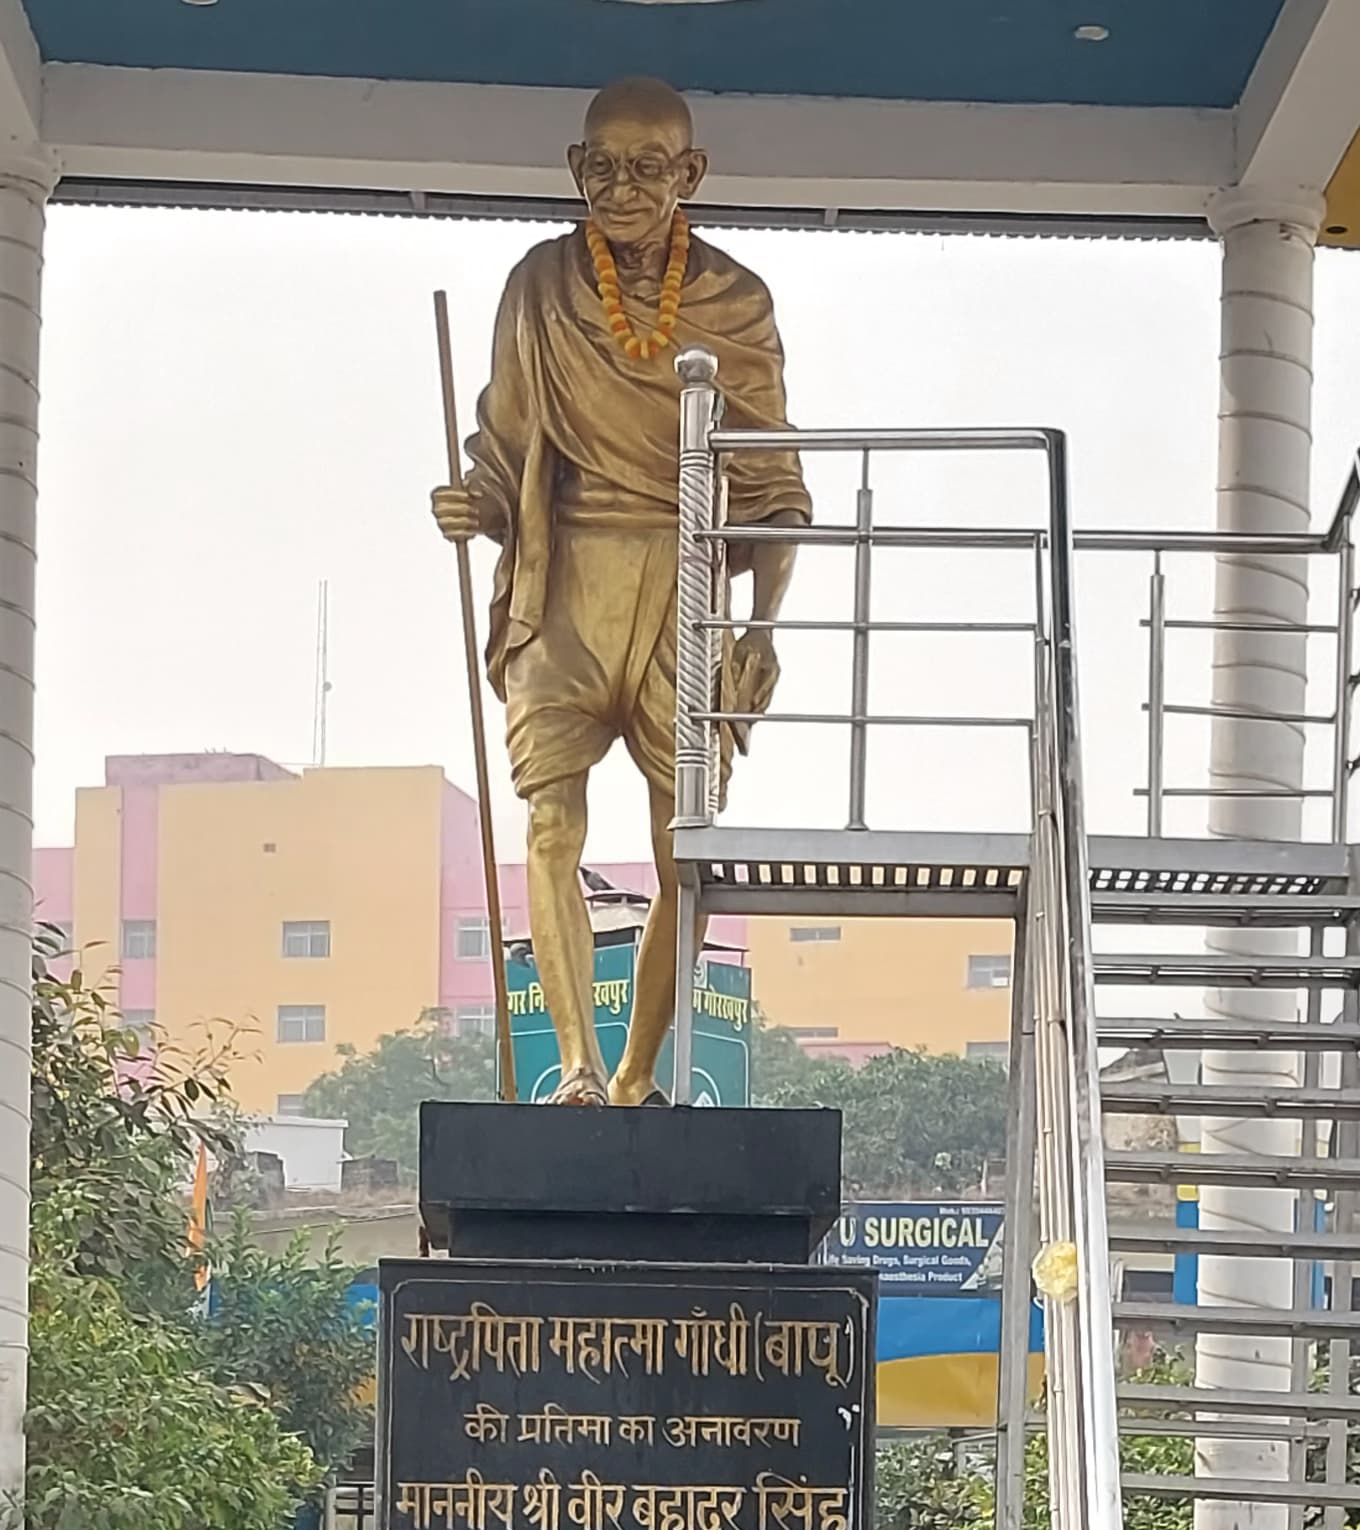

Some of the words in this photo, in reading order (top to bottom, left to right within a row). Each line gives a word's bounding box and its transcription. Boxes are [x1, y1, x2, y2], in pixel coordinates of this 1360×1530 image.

[864, 1216, 990, 1248] SURGICAL
[903, 1254, 940, 1268] Surgical
[927, 1271, 963, 1283] Product
[400, 1302, 544, 1381] राष्ट्रपिता
[548, 1315, 669, 1385] महात्मा
[463, 1403, 509, 1444] की
[516, 1402, 612, 1447] प्रतिमा
[617, 1414, 656, 1447] का
[661, 1416, 802, 1448] अनावरण
[396, 1467, 518, 1530] माननीय
